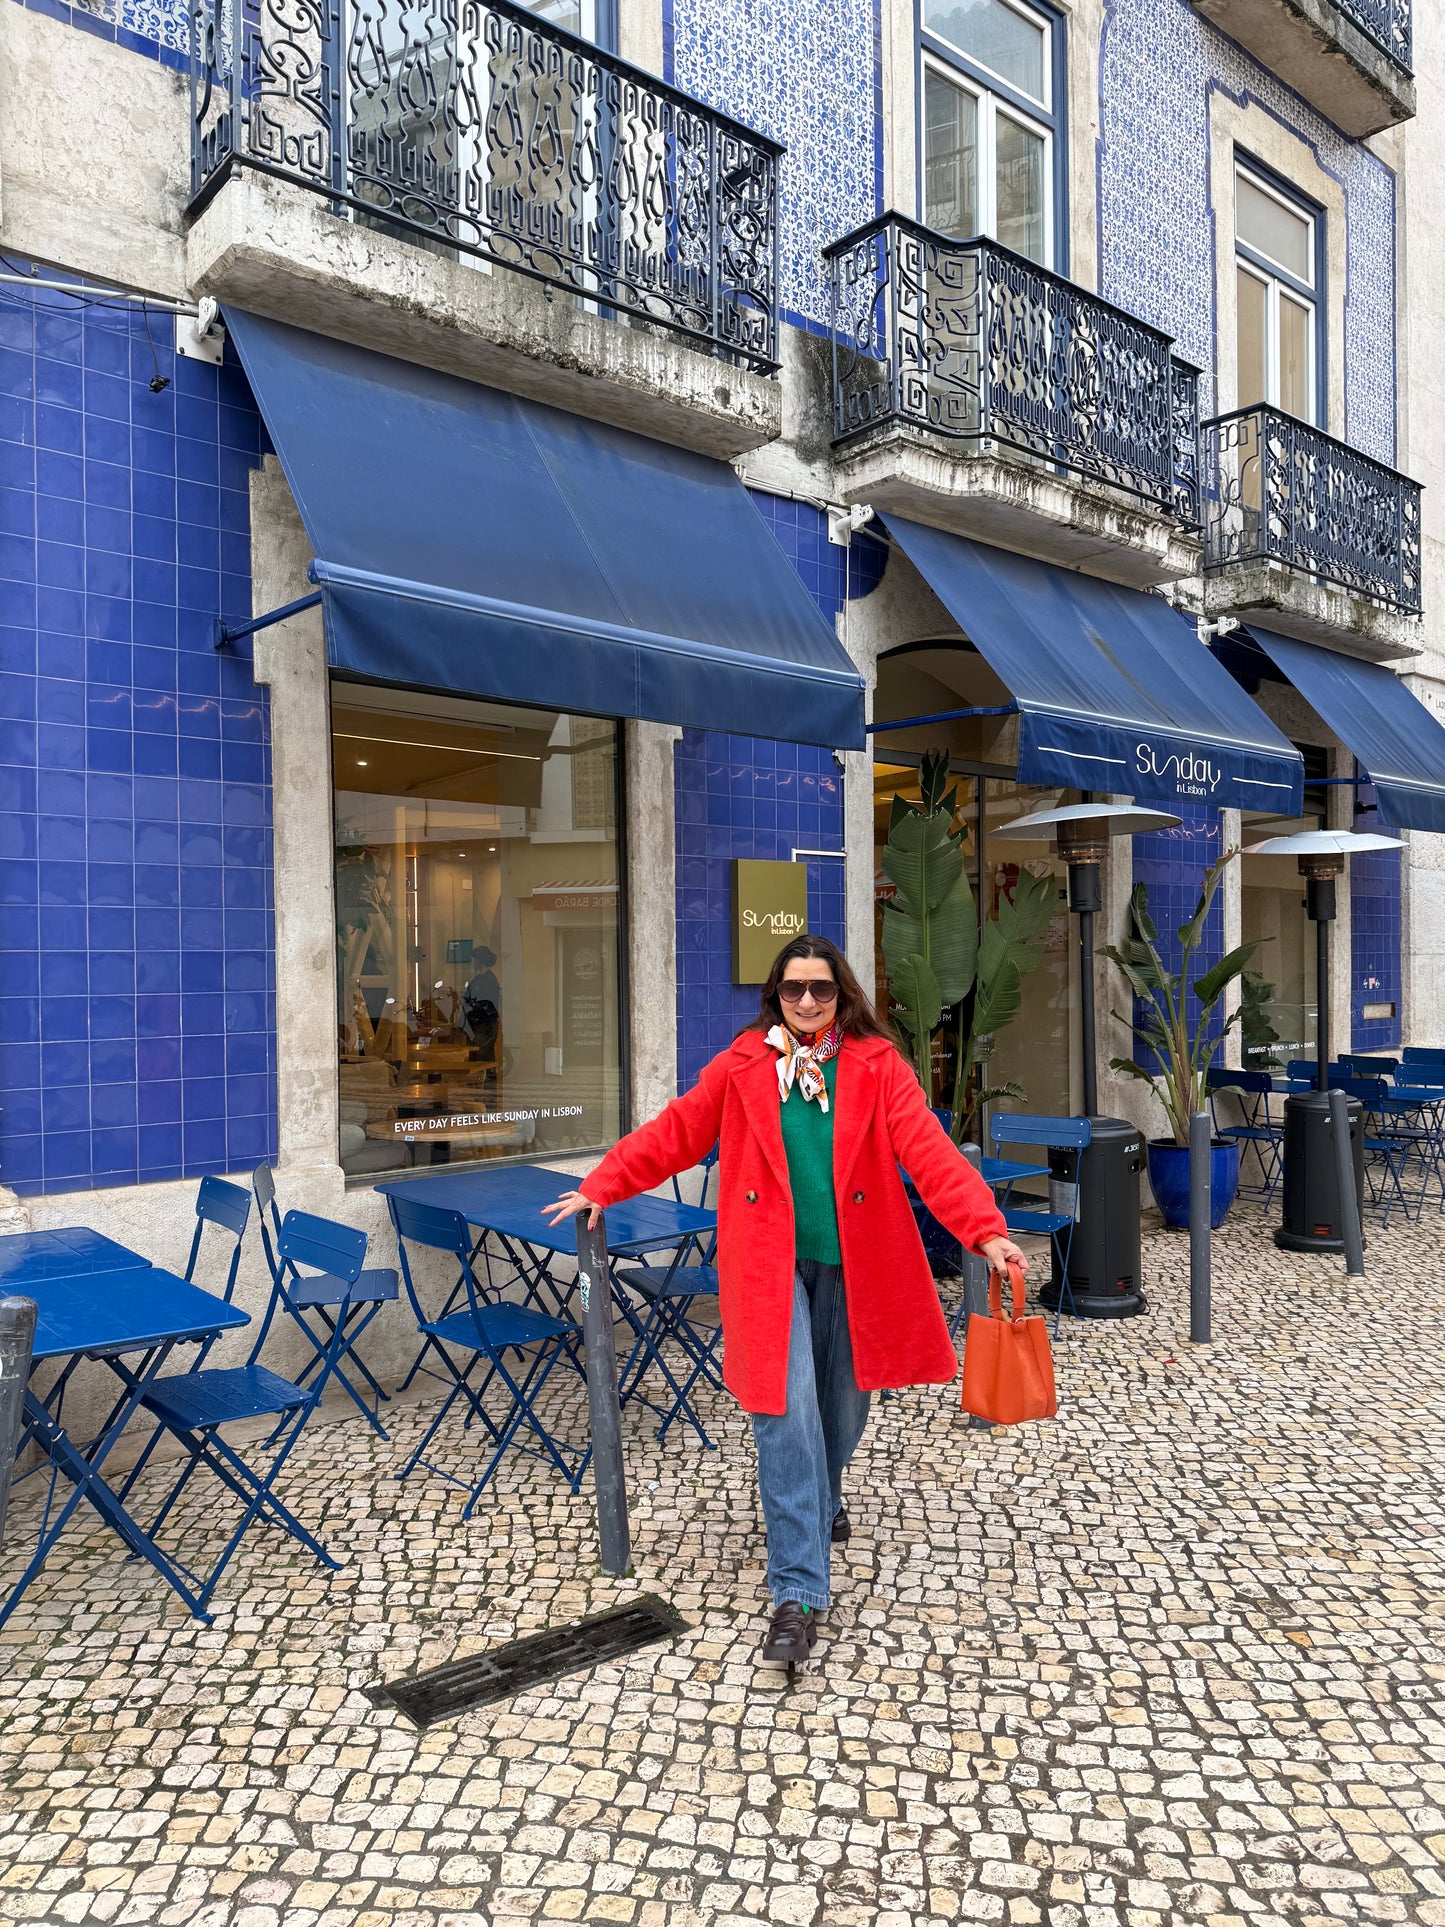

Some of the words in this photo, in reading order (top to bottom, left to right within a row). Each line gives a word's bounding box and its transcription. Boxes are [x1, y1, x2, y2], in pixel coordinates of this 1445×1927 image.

[1136, 743, 1221, 792] Sunday
[1176, 780, 1183, 793] in
[1183, 782, 1207, 796] Lisbon
[743, 909, 804, 932] Sunday
[777, 927, 794, 935] Lisbon
[943, 1013, 951, 1021] PM
[394, 1119, 426, 1133] EVERY
[429, 1118, 448, 1130] DAY
[450, 1115, 479, 1127] FEELS
[481, 1112, 502, 1124] LIKE
[504, 1109, 539, 1122] SUNDAY
[541, 1107, 550, 1118] IN
[552, 1105, 583, 1117] LISBON
